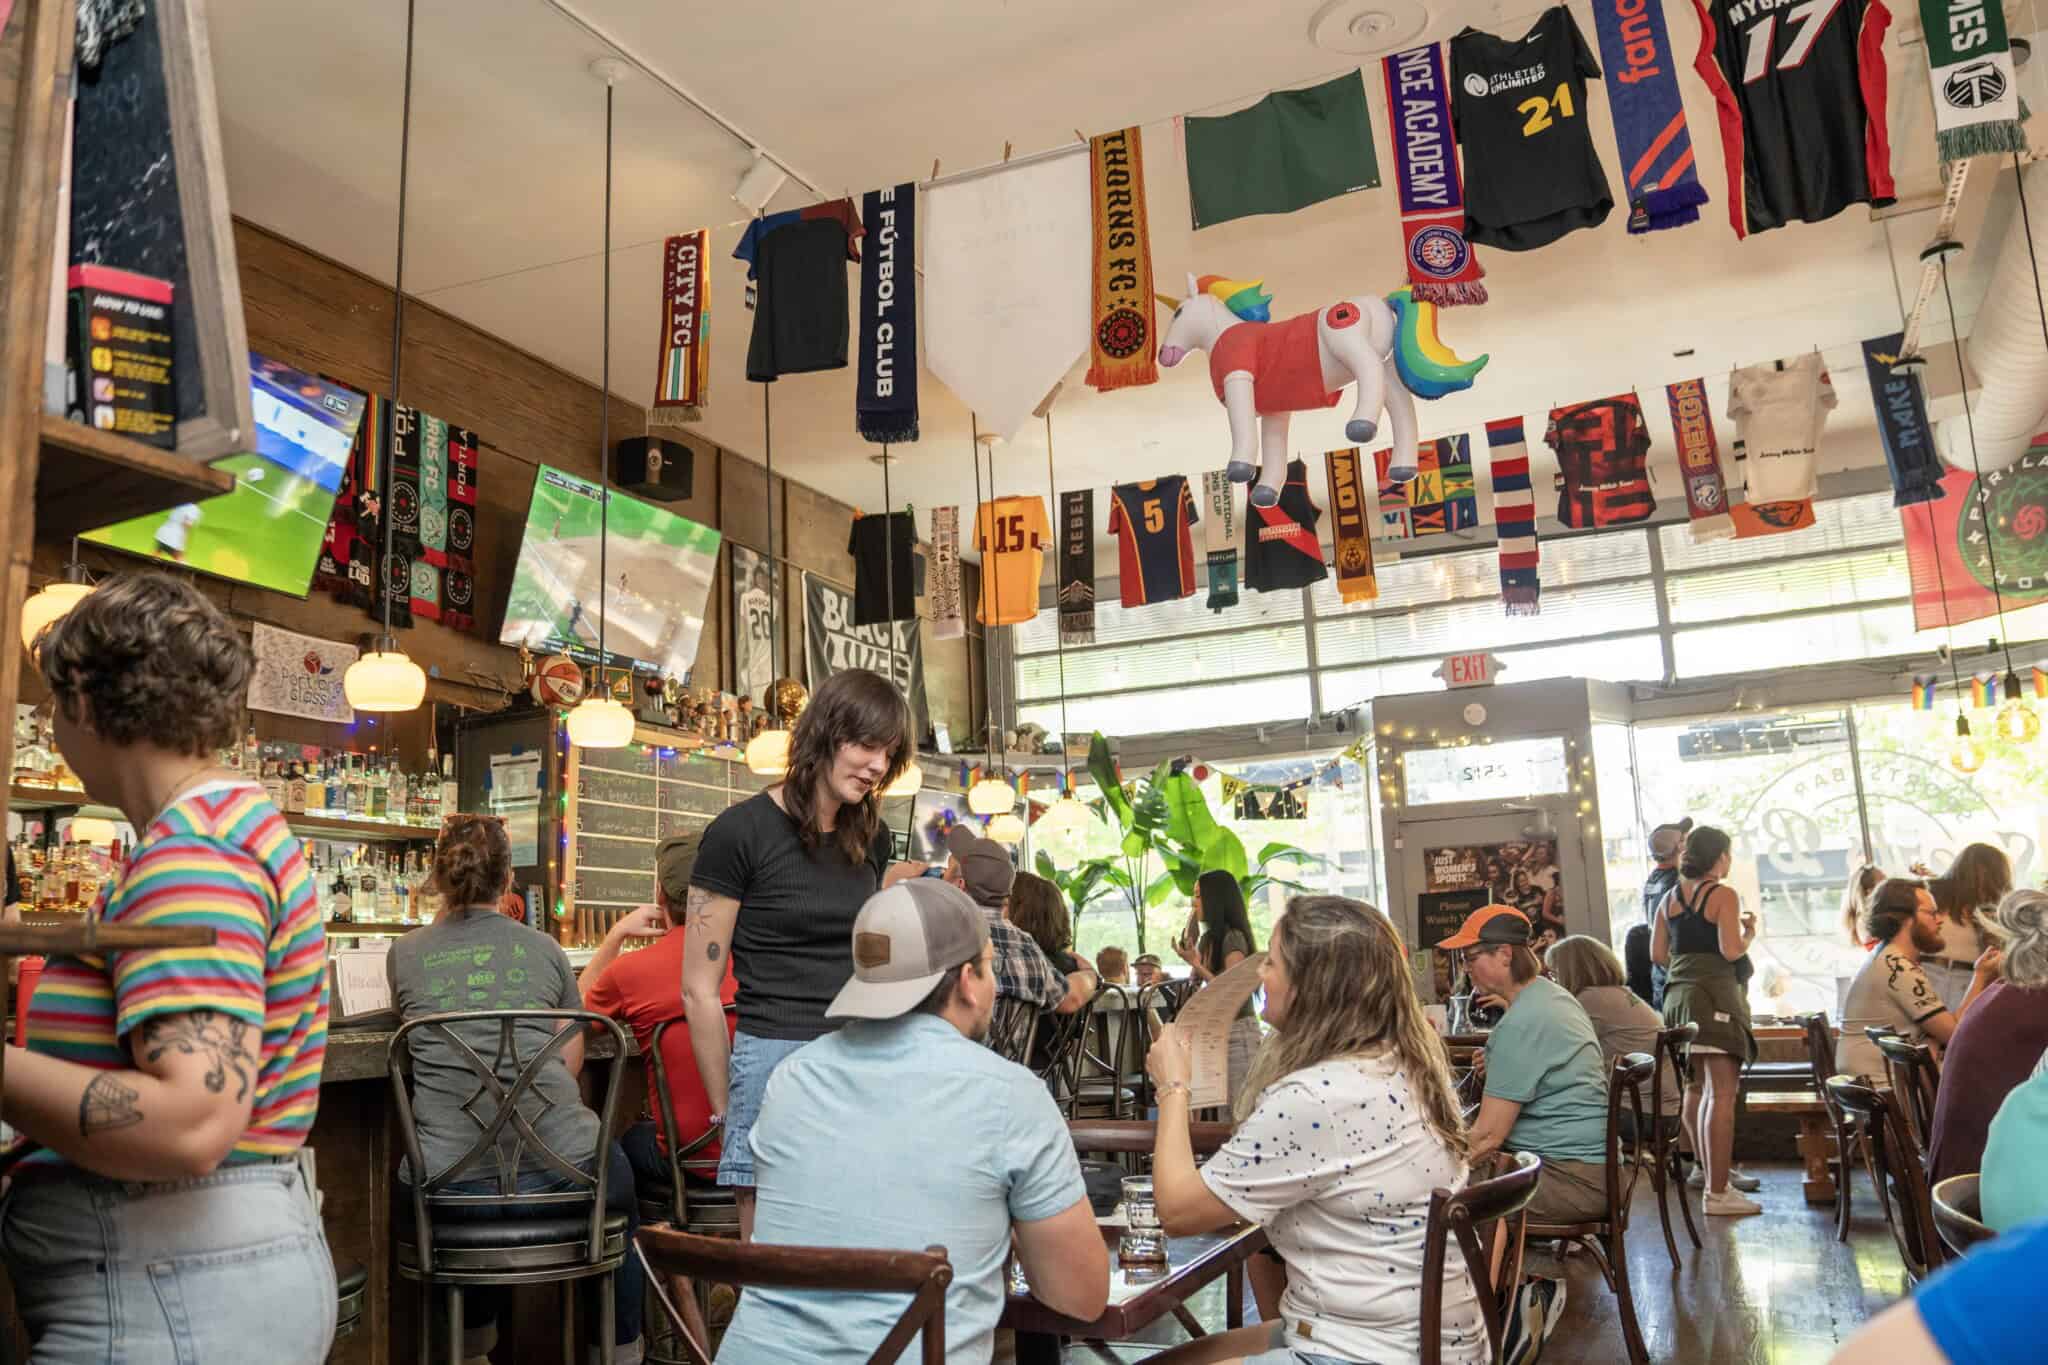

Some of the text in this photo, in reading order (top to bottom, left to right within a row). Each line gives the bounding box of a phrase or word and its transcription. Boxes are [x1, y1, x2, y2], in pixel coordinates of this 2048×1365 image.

[1743, 0, 1841, 84] 17
[1489, 63, 1545, 85] ATHLETES
[1491, 70, 1546, 95] UNLIMITED
[1516, 82, 1575, 137] 21
[1403, 99, 1449, 205] ACADEMY
[1103, 130, 1137, 292] THORNS FC
[674, 245, 698, 307] CITY
[878, 210, 899, 317] FÚTBOL
[673, 312, 692, 345] FC
[876, 323, 894, 397] CLUB
[1676, 379, 1713, 468] REIGN
[1885, 379, 1920, 449] MAKE
[996, 514, 1025, 554] 15
[1070, 492, 1084, 555] REBEL
[1143, 498, 1165, 534] 5
[749, 608, 770, 640] 20
[1451, 653, 1487, 683] EXIT
